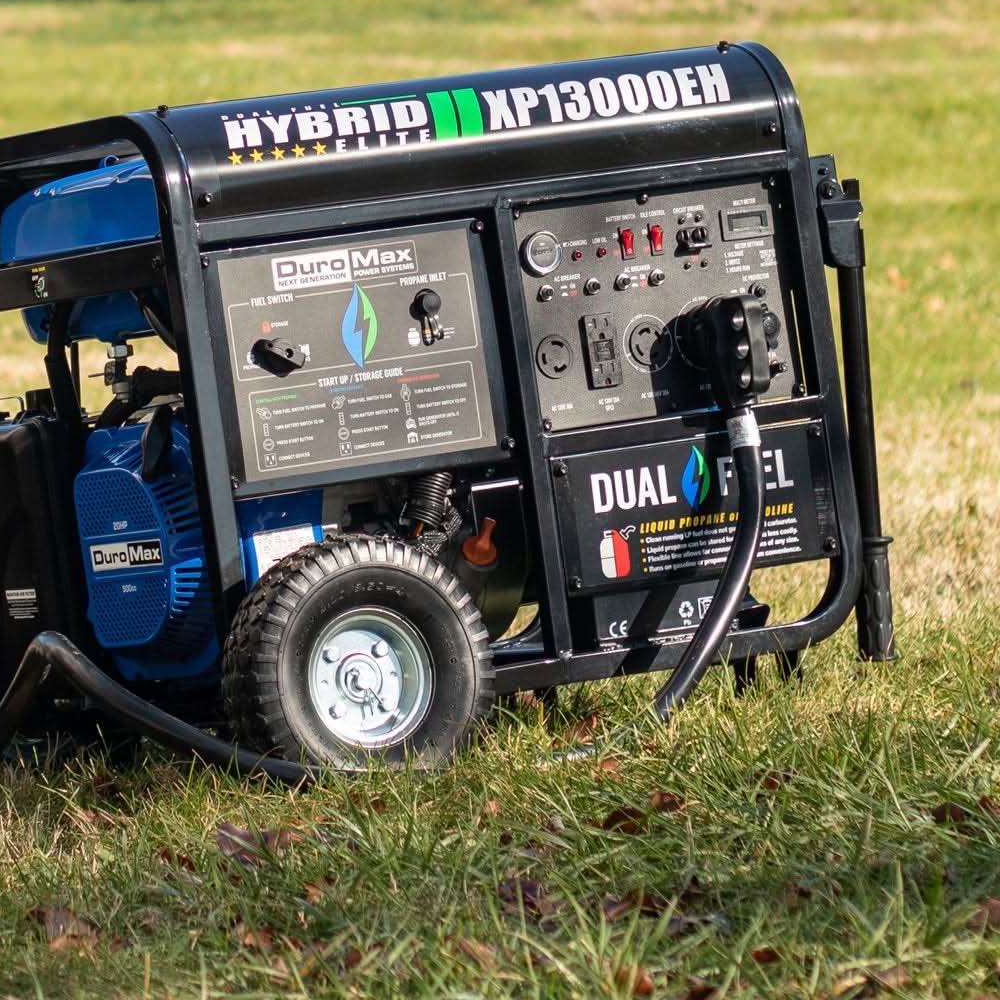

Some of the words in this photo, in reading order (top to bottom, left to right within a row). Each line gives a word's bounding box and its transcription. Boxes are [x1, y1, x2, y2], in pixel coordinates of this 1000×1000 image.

[481, 63, 731, 131] XP13000EH
[223, 100, 428, 149] HYBRID
[335, 129, 431, 153] ELITE
[279, 279, 298, 287] NEXT
[300, 272, 347, 284] GENERATION
[353, 267, 380, 277] POWER
[381, 262, 415, 274] SYSTEMS
[399, 274, 427, 287] PROPANE
[428, 271, 447, 284] INLET
[250, 296, 267, 308] FUEL
[267, 293, 294, 305] SWITCH
[318, 375, 338, 388] START
[340, 374, 350, 385] UP
[354, 369, 384, 383] STORAGE
[384, 366, 404, 378] GUIDE
[590, 464, 677, 514] DUAL
[716, 448, 795, 497] FEL
[640, 519, 676, 534] LIQUID
[679, 512, 726, 528] PROPANE
